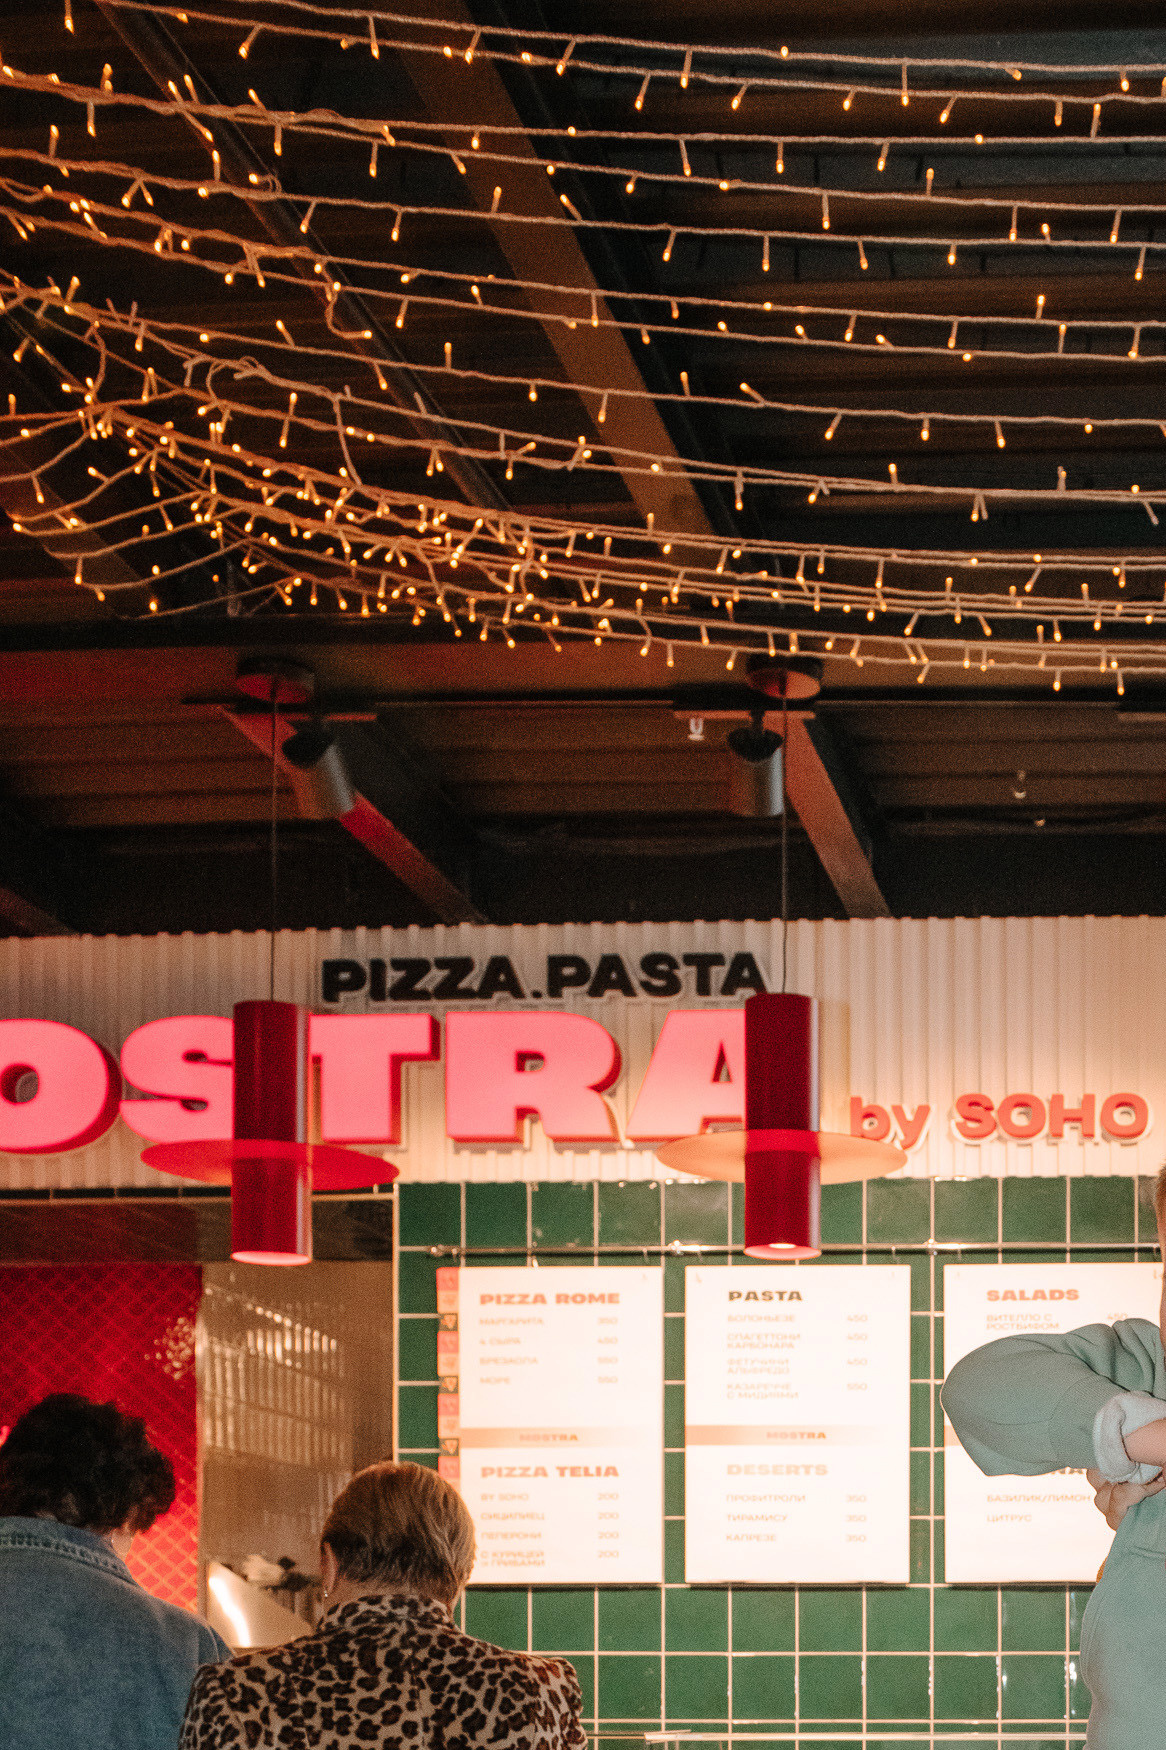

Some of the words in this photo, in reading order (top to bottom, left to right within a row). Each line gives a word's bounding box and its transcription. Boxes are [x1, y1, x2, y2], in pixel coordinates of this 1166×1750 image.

[322, 950, 768, 1001] PIZZA.PASTA
[849, 1096, 931, 1151] by
[952, 1092, 1149, 1141] SOHO
[479, 1292, 548, 1306] PIZZA
[555, 1292, 621, 1305] ROME
[728, 1290, 803, 1302] PASTA
[986, 1289, 1079, 1302] SALADS
[986, 1313, 1041, 1321] ВИТЕЛЛО
[986, 1322, 1060, 1330] РОСТБИФОМ
[480, 1466, 548, 1478] PIZZA
[556, 1465, 619, 1478] TELIA
[727, 1464, 829, 1476] DESERTS
[597, 1492, 619, 1501] 200
[726, 1494, 807, 1503] ПРОФИТРОЛИ
[987, 1494, 1090, 1503] БАЗИЛИК/ЛИМОН
[597, 1512, 619, 1520] 200
[726, 1514, 787, 1523] ТИРАМИСУ
[987, 1513, 1032, 1523] ЦИТРУС
[597, 1531, 619, 1540] 200
[726, 1534, 777, 1542] КАПРЕЗЕ
[597, 1550, 619, 1558] 200
